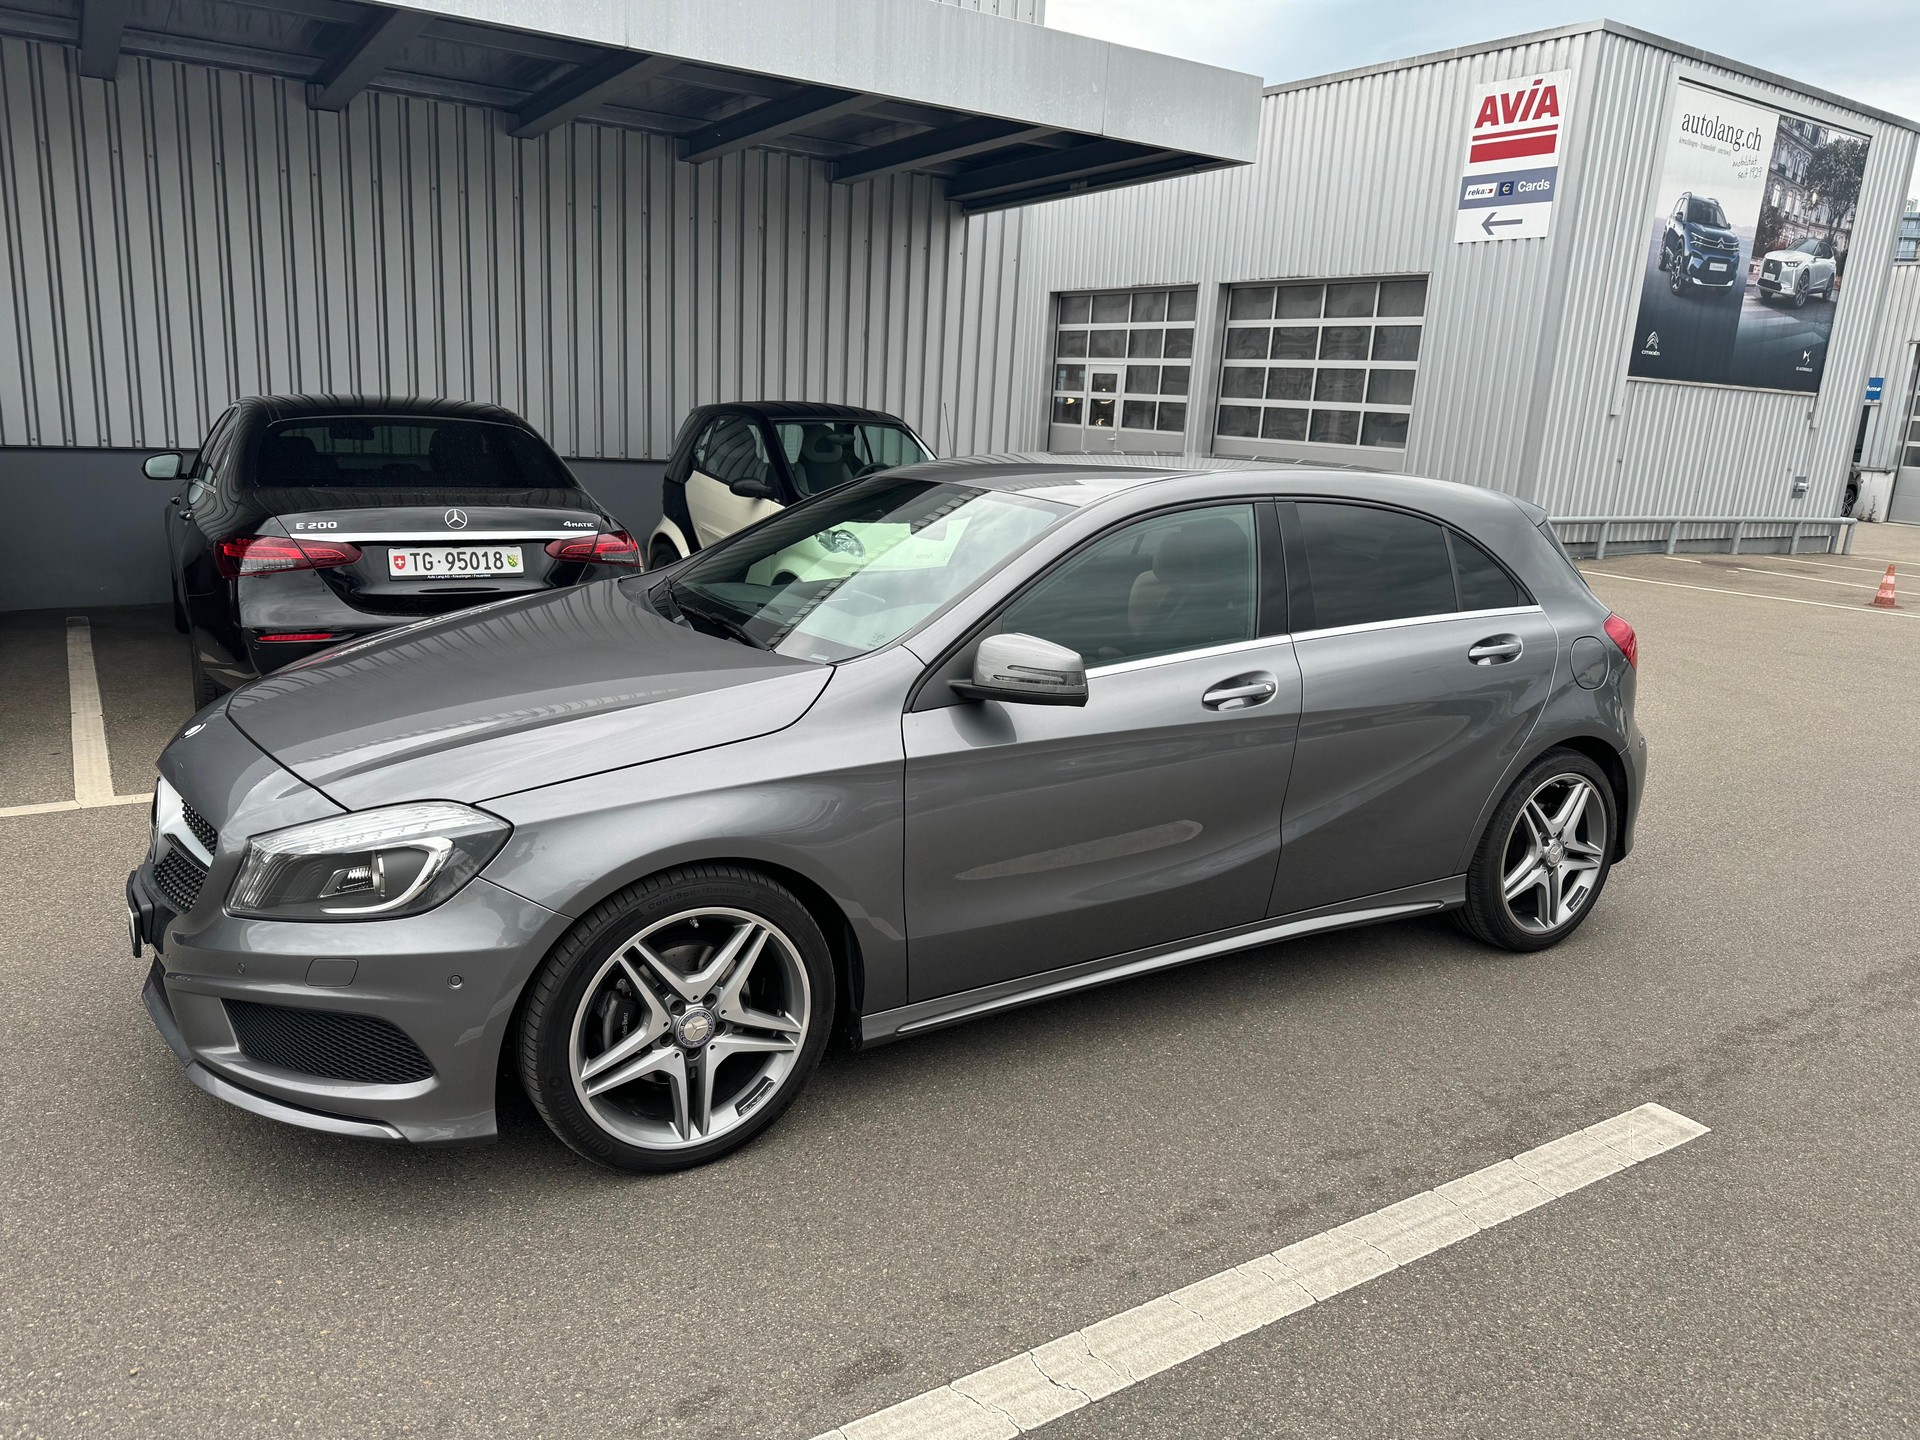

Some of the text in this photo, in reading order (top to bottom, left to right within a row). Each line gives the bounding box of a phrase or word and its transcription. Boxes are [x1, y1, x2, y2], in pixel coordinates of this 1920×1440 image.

[1681, 113, 1762, 152] autolang.ch
[1517, 178, 1550, 193] Cards
[295, 521, 338, 530] E 200
[563, 520, 595, 528] 4MATIC
